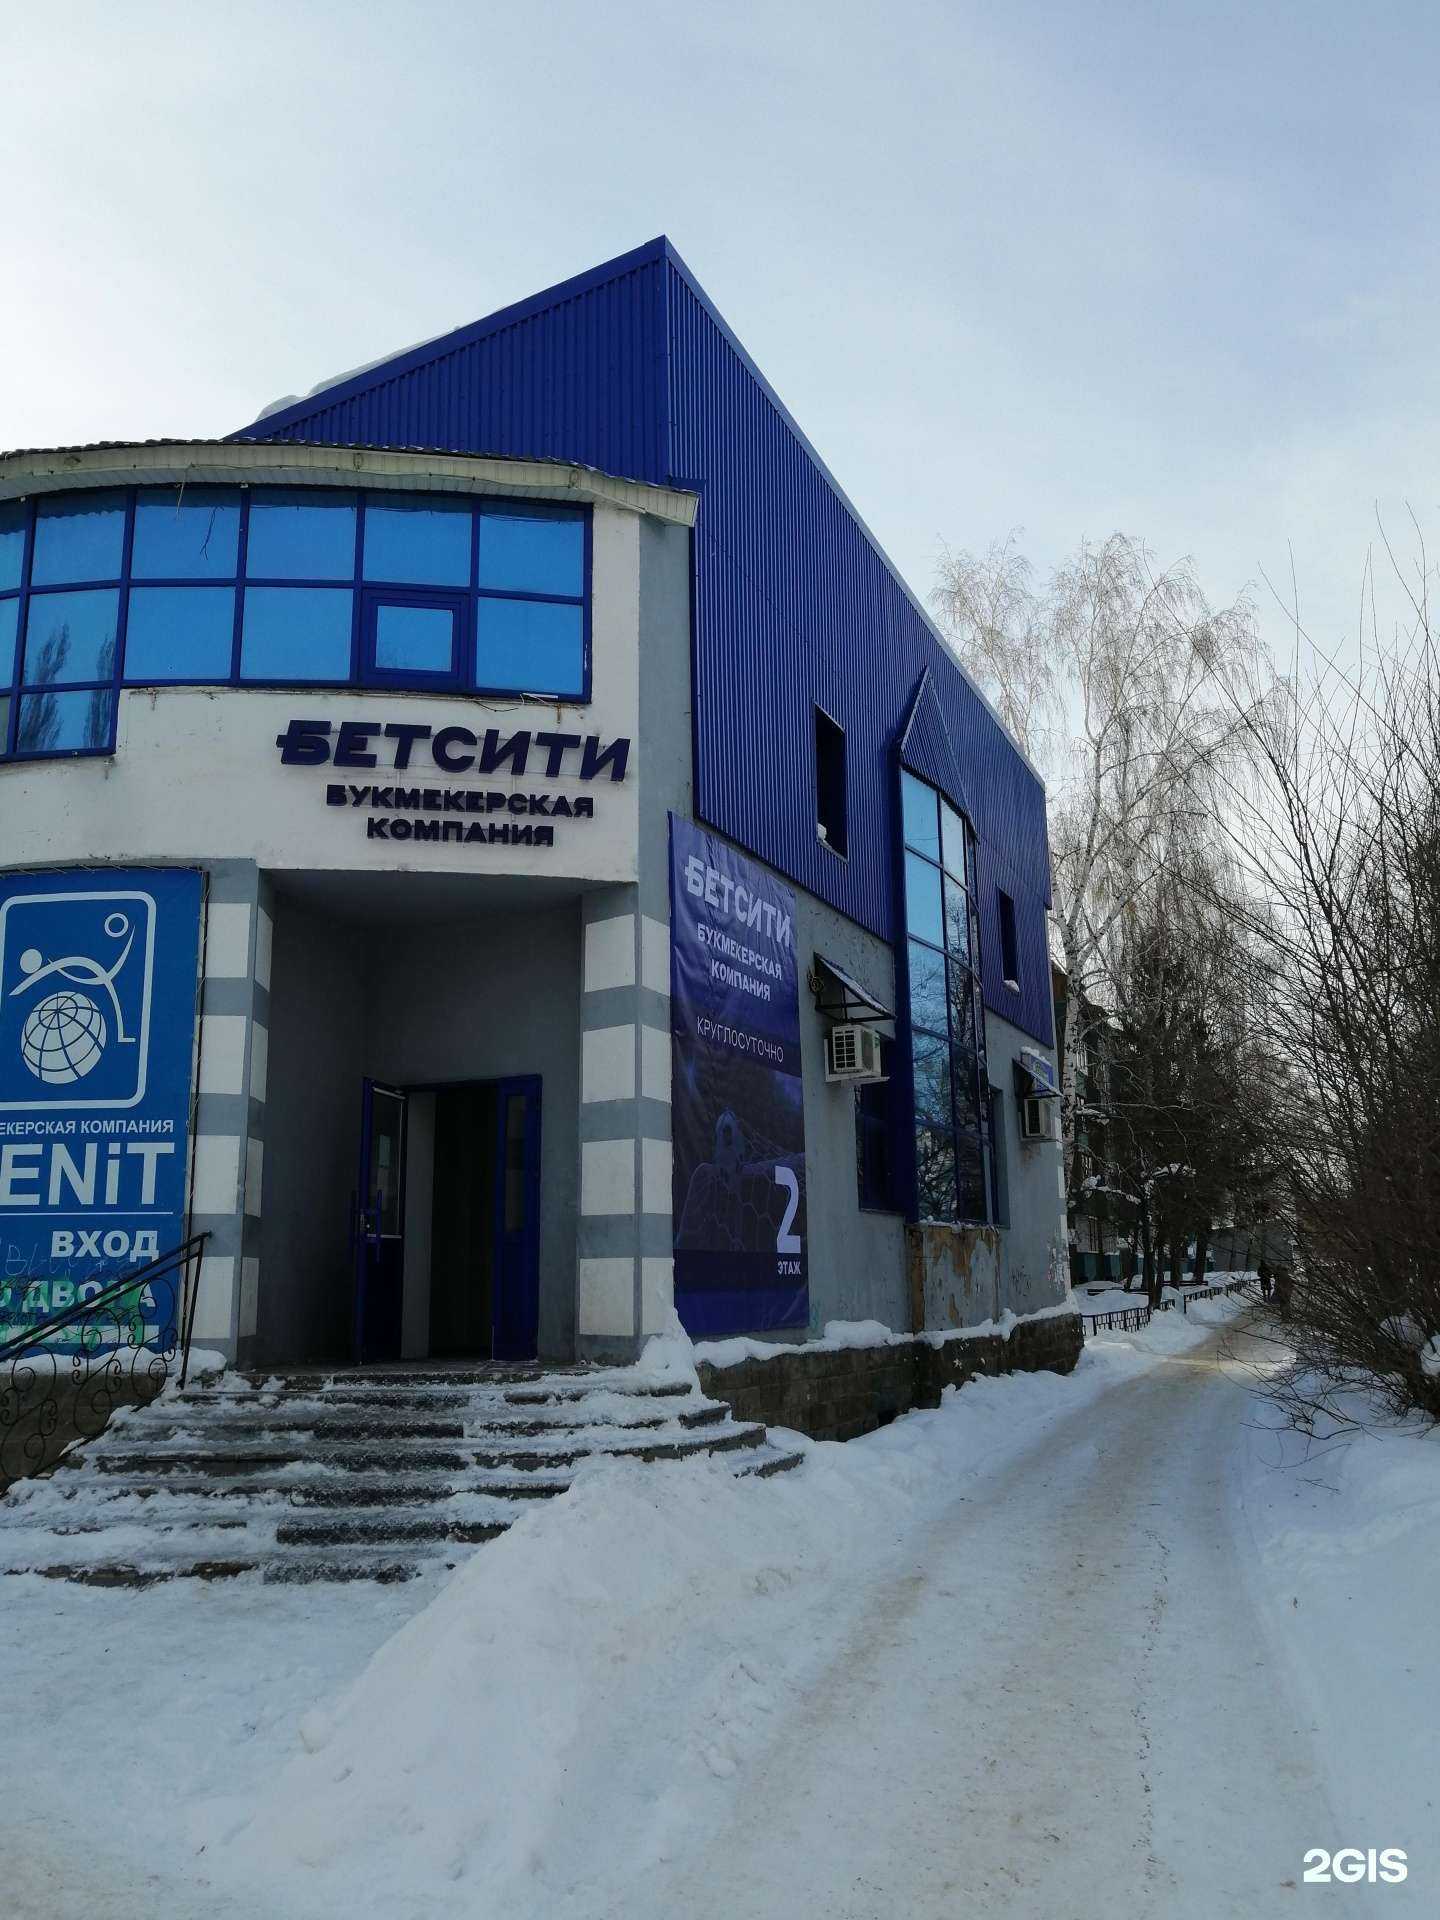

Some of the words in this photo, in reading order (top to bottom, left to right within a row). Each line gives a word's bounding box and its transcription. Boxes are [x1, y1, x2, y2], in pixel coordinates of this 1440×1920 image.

[276, 719, 631, 782] БЕТСИТИ
[326, 784, 594, 819] БУКМЕКЕРСКАЯ
[366, 817, 554, 847] КОМПАНИЯ
[685, 855, 791, 947] БЕТСИТИ
[697, 923, 782, 980] БУКМЕКЕРСКАЯ
[711, 959, 771, 1002] КОМПАНИЯ
[697, 1016, 784, 1064] КРУГЛОСУТОЧНО
[80, 1119, 174, 1133] КОМПАНИЯ
[775, 1165, 801, 1253] 2
[51, 1230, 160, 1263] ВХОД
[777, 1261, 801, 1275] ЭТАЖ
[22, 1280, 156, 1312] ДВОА
